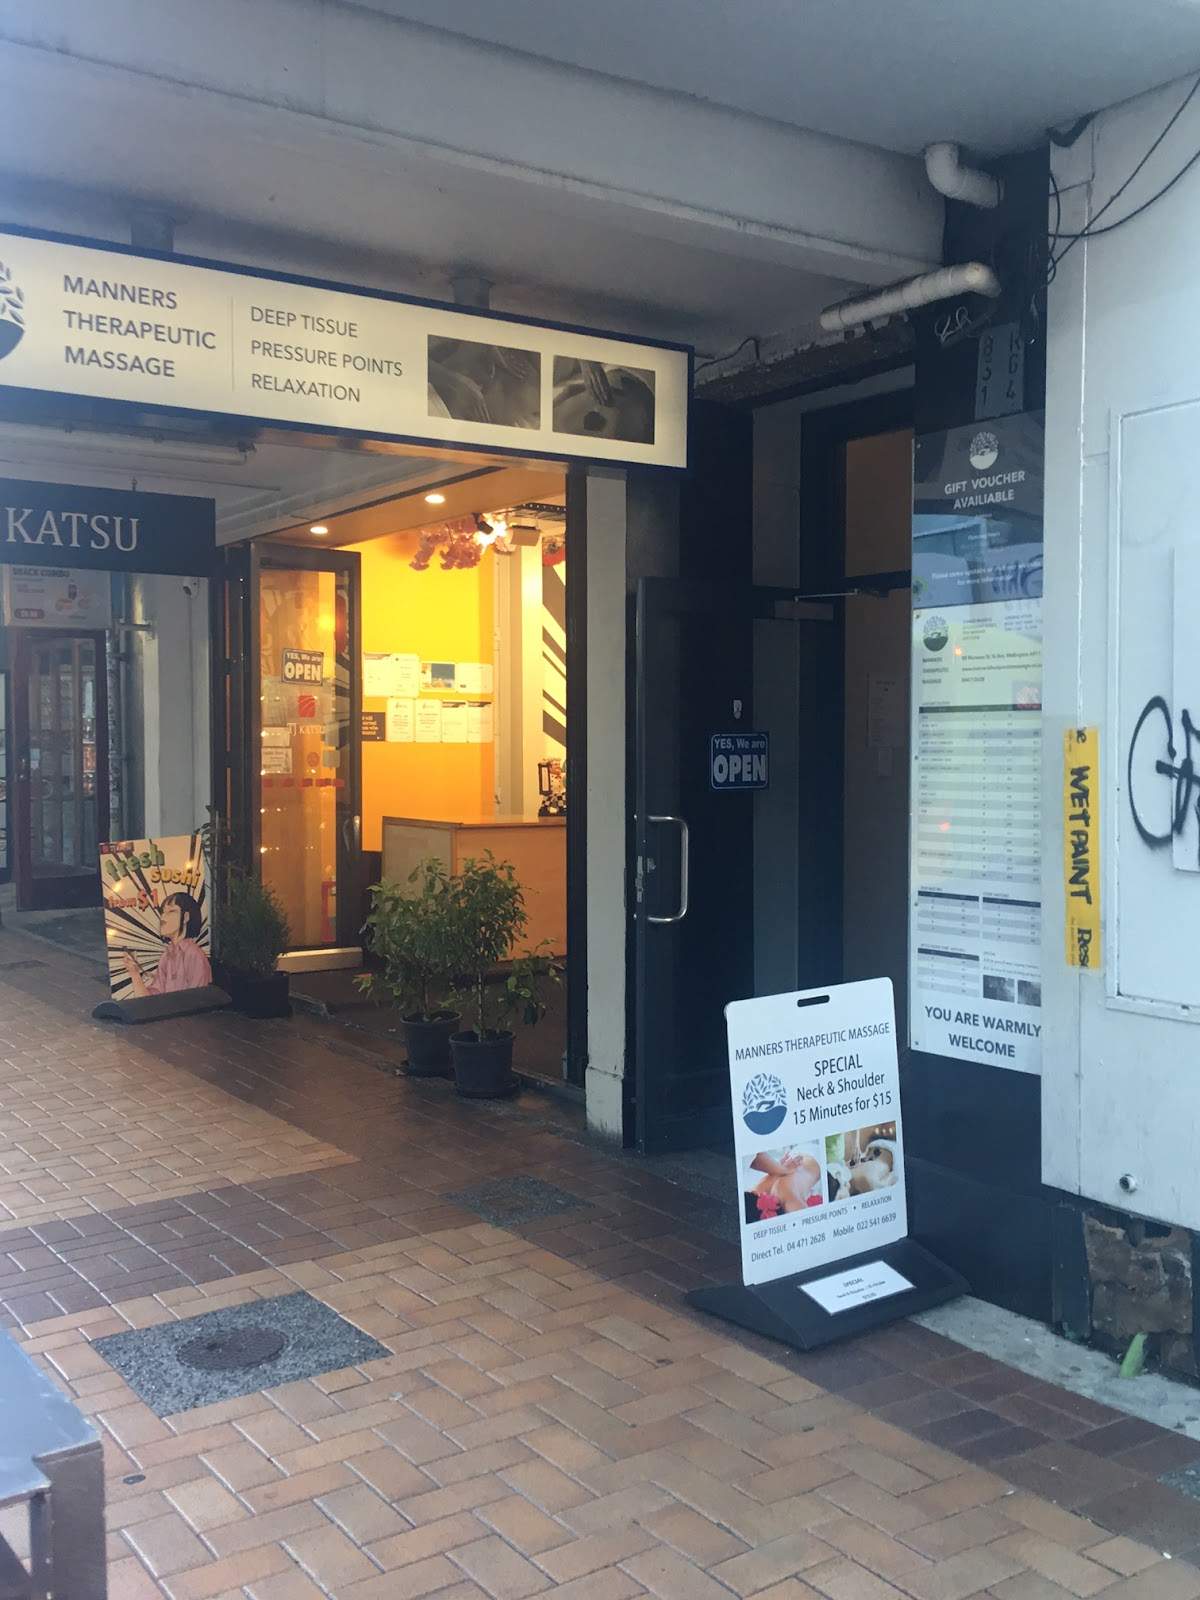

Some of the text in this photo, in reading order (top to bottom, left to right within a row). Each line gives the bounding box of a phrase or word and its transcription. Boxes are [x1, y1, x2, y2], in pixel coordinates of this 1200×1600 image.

[63, 275, 178, 310] MANNERS
[63, 310, 217, 350] THERAPEUTIC
[250, 305, 359, 338] DEEP TISSUE
[65, 345, 176, 378] MASSAGE
[250, 339, 403, 377] PRESSURE POINTS
[251, 373, 361, 403] RELAXATION
[944, 470, 1026, 496] GIFT VOUCHER
[953, 489, 1015, 511] AVAILIABLE
[5, 506, 140, 552] KATSU
[284, 661, 321, 681] OPEN
[714, 738, 766, 751] YES, We are
[713, 754, 766, 783] OPEN
[1068, 765, 1092, 905] WET PAINT
[105, 843, 165, 882] fresh
[150, 868, 201, 889] sushi
[925, 1005, 1042, 1038] YOU ARE WARMLY
[735, 1022, 891, 1061] MANNERS THERAPEUTIC MASSAGE
[948, 1033, 1016, 1058] WELCOME
[814, 1054, 863, 1077] SPECIAL
[797, 1072, 886, 1101] Neck & Shoulder
[793, 1090, 893, 1126] 15 Minutes for $15
[751, 1249, 772, 1263] Direct
[786, 1241, 796, 1252] 04
[796, 1237, 809, 1250] 471
[810, 1232, 827, 1245] 2628
[832, 1225, 855, 1238] Mobile
[856, 1220, 869, 1232] 022
[869, 1216, 881, 1229] 541
[753, 1229, 768, 1241] DEEP
[768, 1223, 788, 1237] TISSUE
[801, 1213, 828, 1227] PRESSURE
[828, 1206, 849, 1220] POINTS
